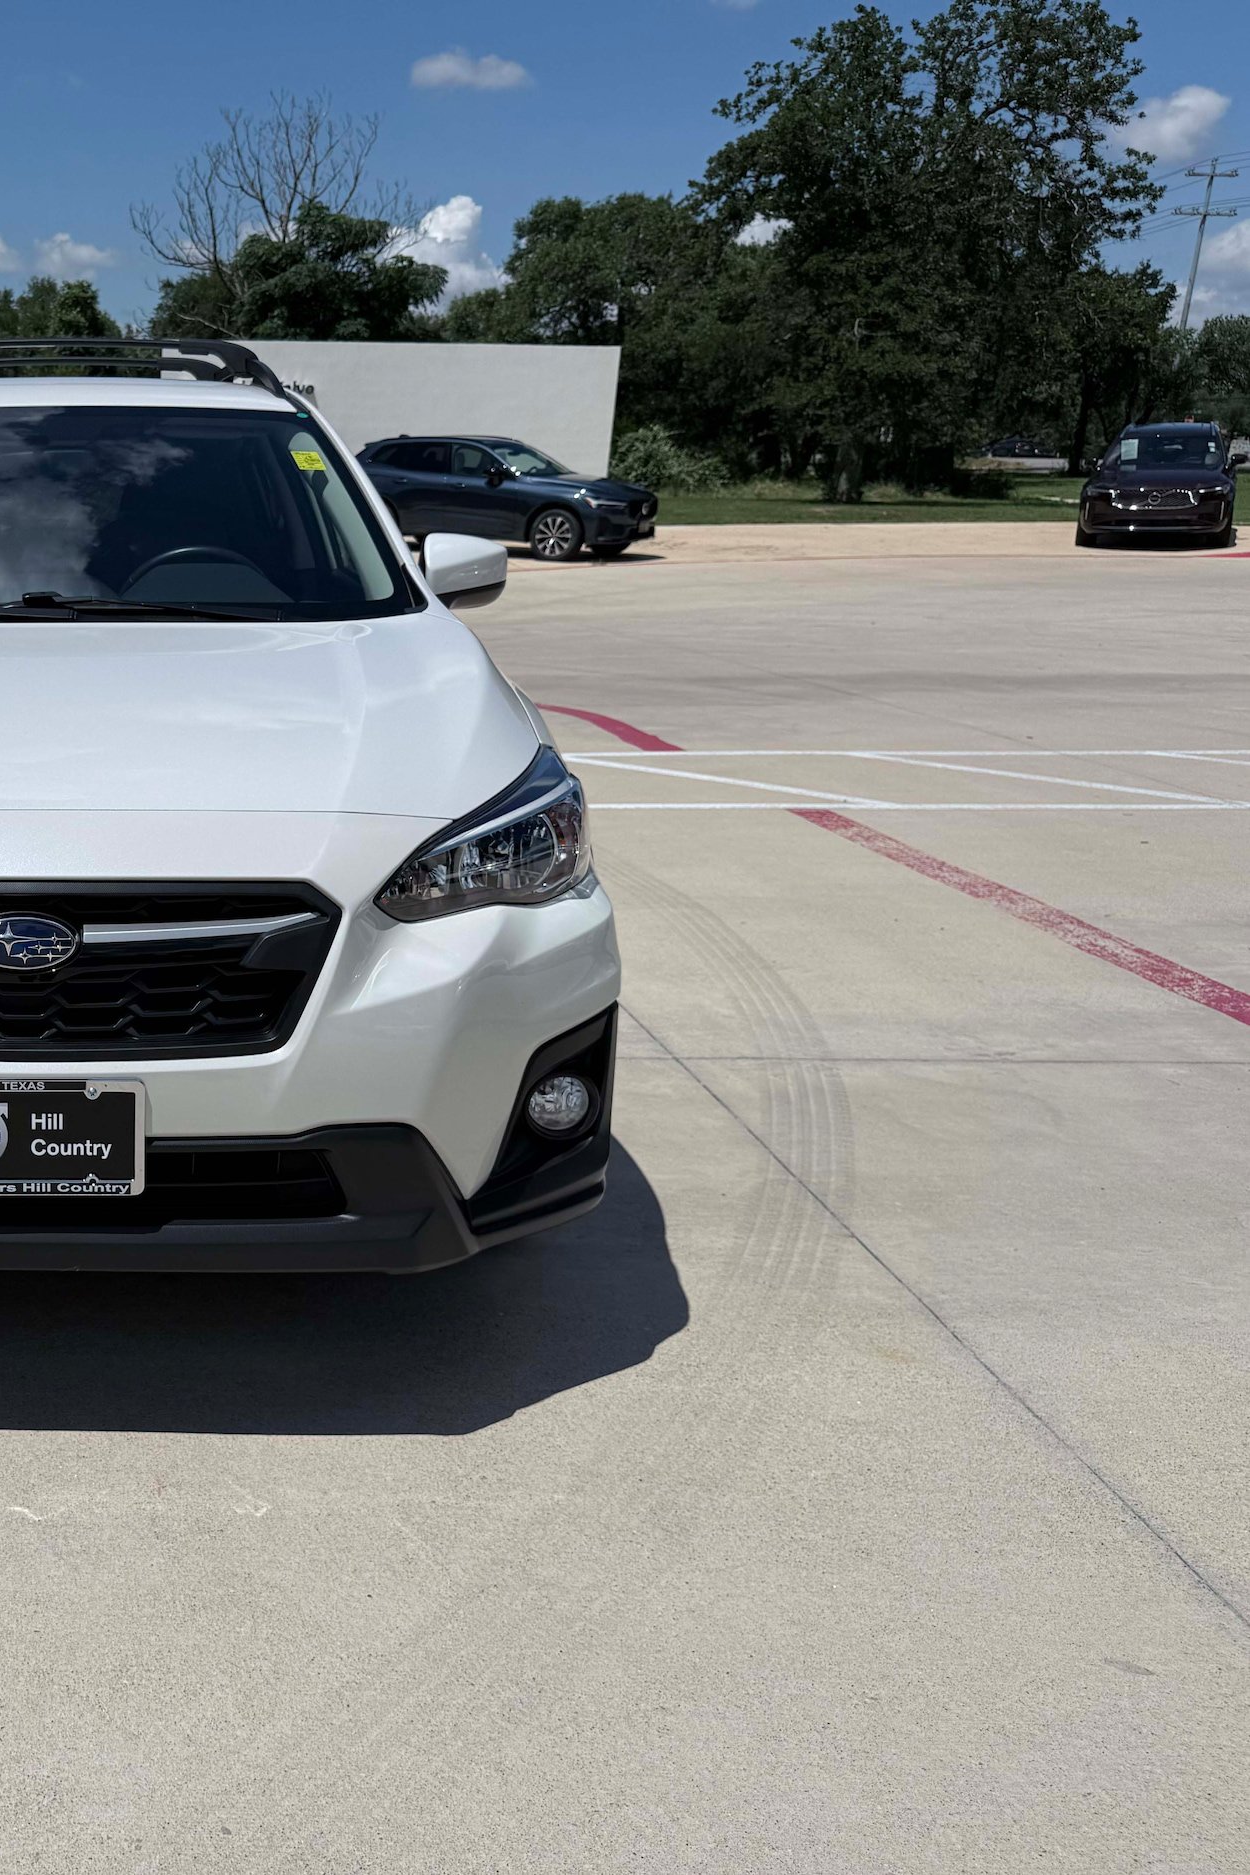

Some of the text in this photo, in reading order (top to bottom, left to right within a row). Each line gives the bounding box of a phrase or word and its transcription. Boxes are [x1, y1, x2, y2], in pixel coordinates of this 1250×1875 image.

[2, 1081, 45, 1091] TEXAS
[31, 1113, 63, 1130] Hill
[30, 1138, 112, 1159] Country
[22, 1182, 51, 1193] Hill
[56, 1182, 130, 1195] Country
